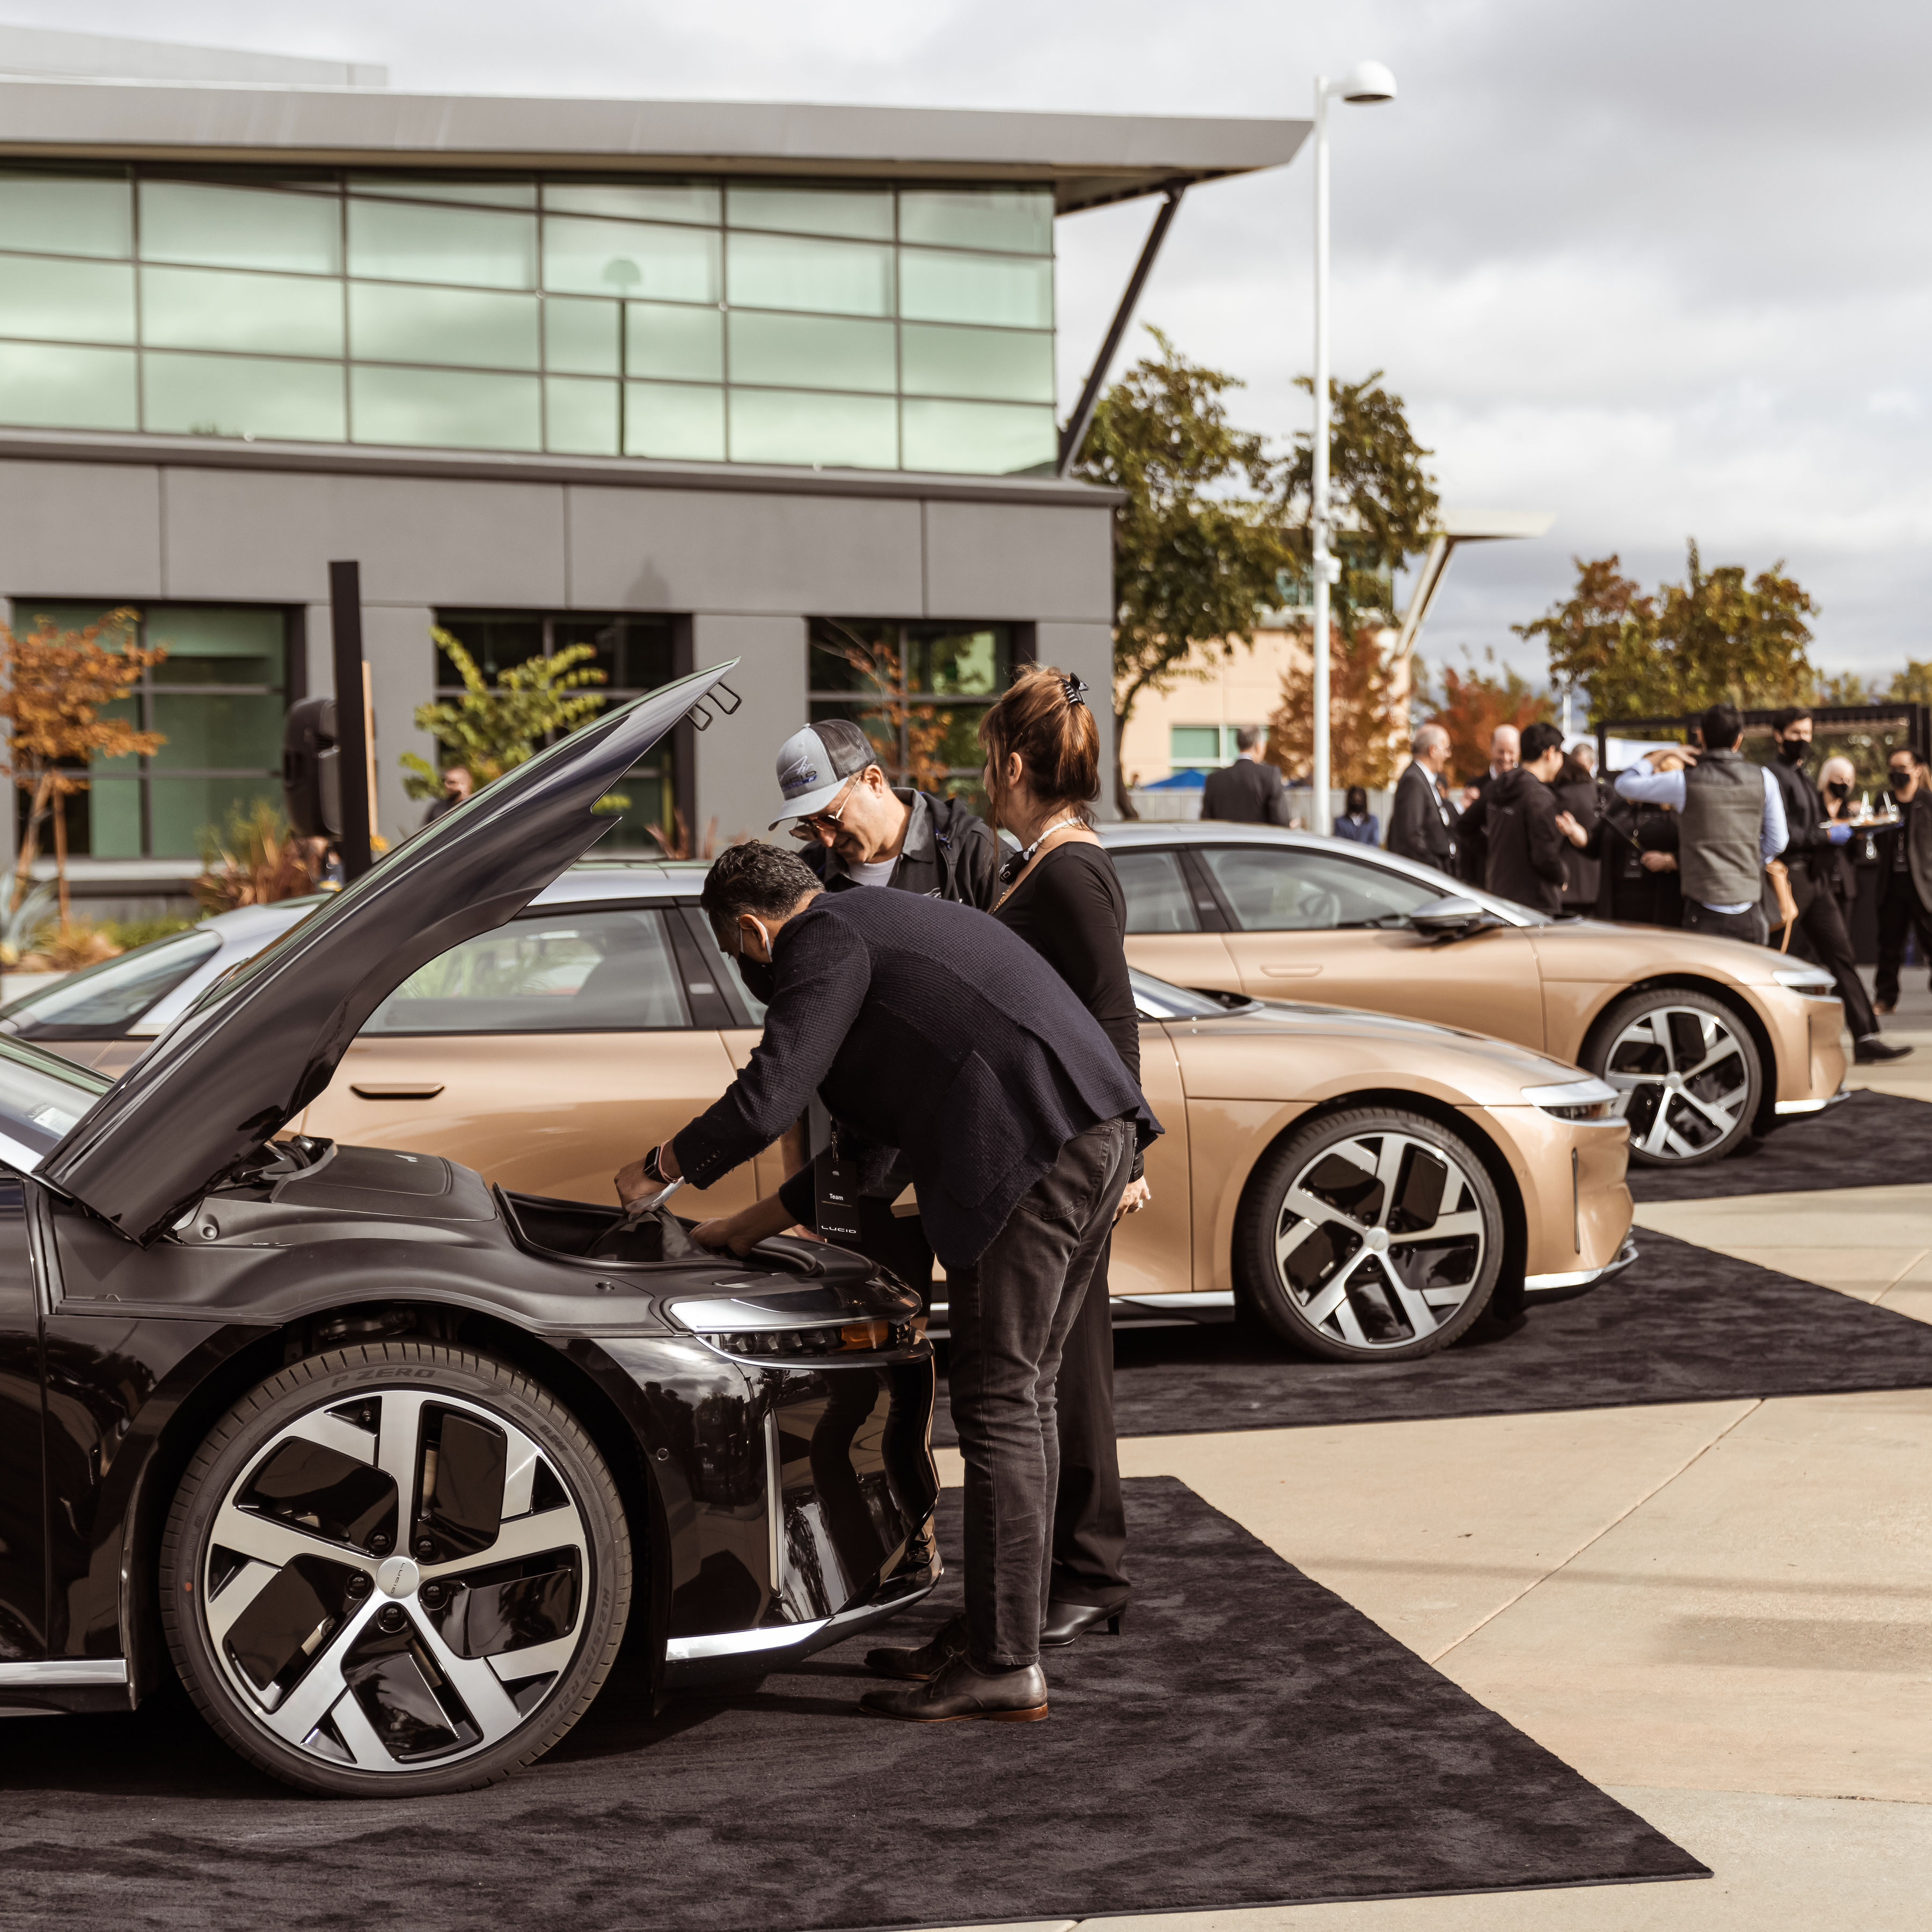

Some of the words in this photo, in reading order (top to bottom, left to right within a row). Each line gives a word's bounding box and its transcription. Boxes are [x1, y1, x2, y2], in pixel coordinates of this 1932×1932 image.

[821, 1225, 857, 1234] LUCID
[331, 1375, 349, 1388] P
[355, 1368, 436, 1381] ZERO
[391, 1563, 405, 1593] LUCID
